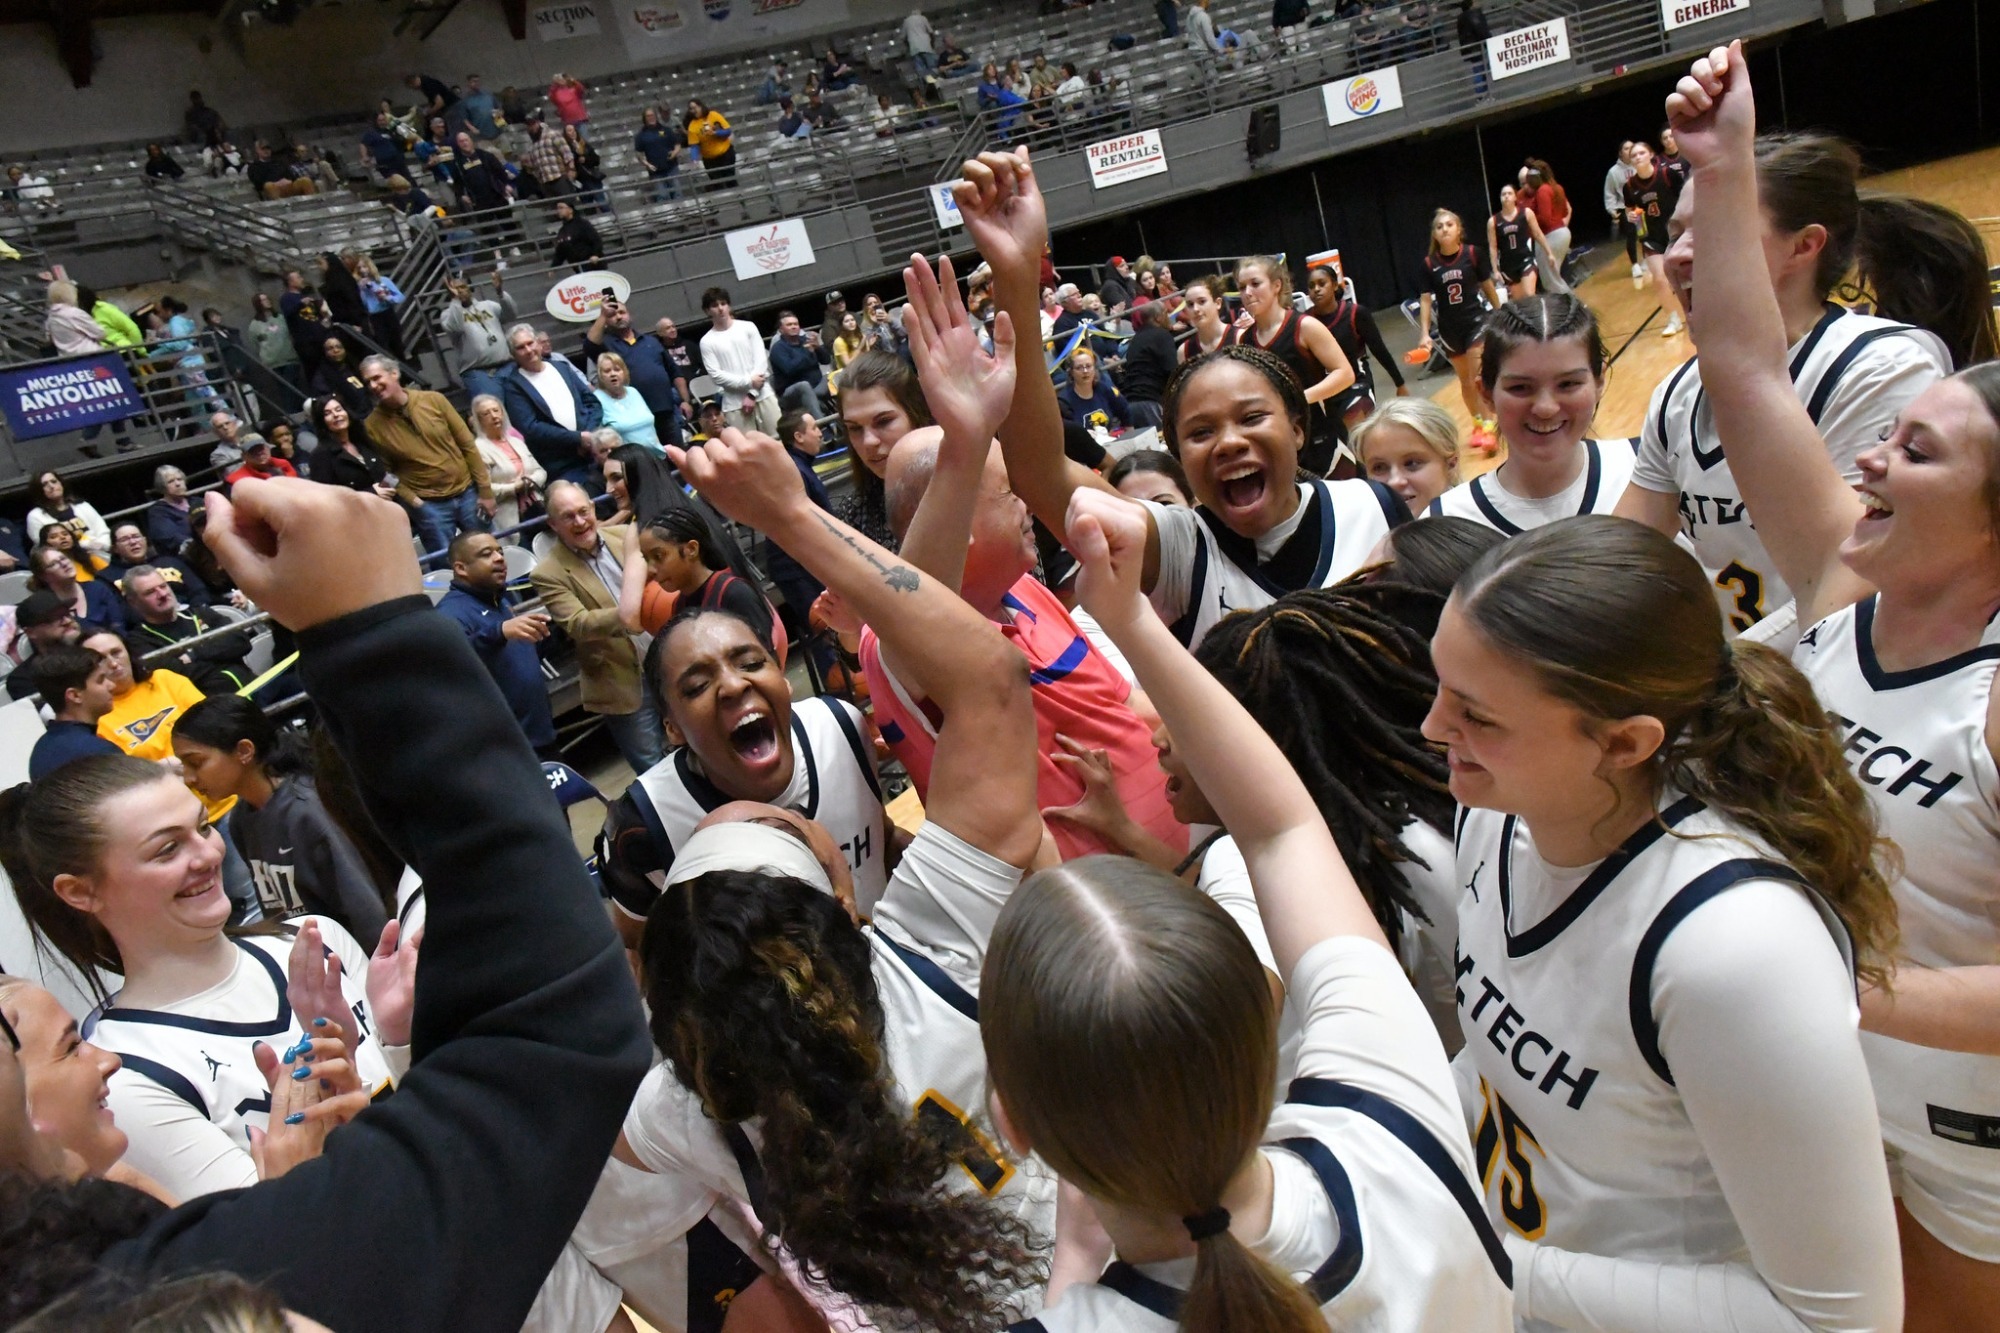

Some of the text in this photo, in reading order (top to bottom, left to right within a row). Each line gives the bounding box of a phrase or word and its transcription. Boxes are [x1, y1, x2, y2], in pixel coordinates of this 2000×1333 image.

[534, 5, 595, 24] SECTION
[1675, 0, 1737, 23] GENERAL
[564, 21, 575, 34] 5
[1504, 26, 1549, 48] BECKLEY
[1497, 35, 1558, 62] VETERINARY
[1505, 48, 1557, 70] HOSPITAL
[1349, 80, 1375, 100] BURGER
[1352, 87, 1377, 110] KING
[1090, 136, 1145, 157] HARPER
[1100, 144, 1159, 167] RENTALS
[1648, 202, 1660, 216] 4
[558, 285, 586, 304] Little
[570, 290, 602, 314] Gene
[1447, 283, 1463, 305] 2
[27, 369, 95, 392] MICHAEL
[20, 378, 124, 412] ANTOLINI
[27, 398, 131, 425] STATE SENATE
[1471, 976, 1600, 1111] TECH
[1474, 1072, 1547, 1240] 15
